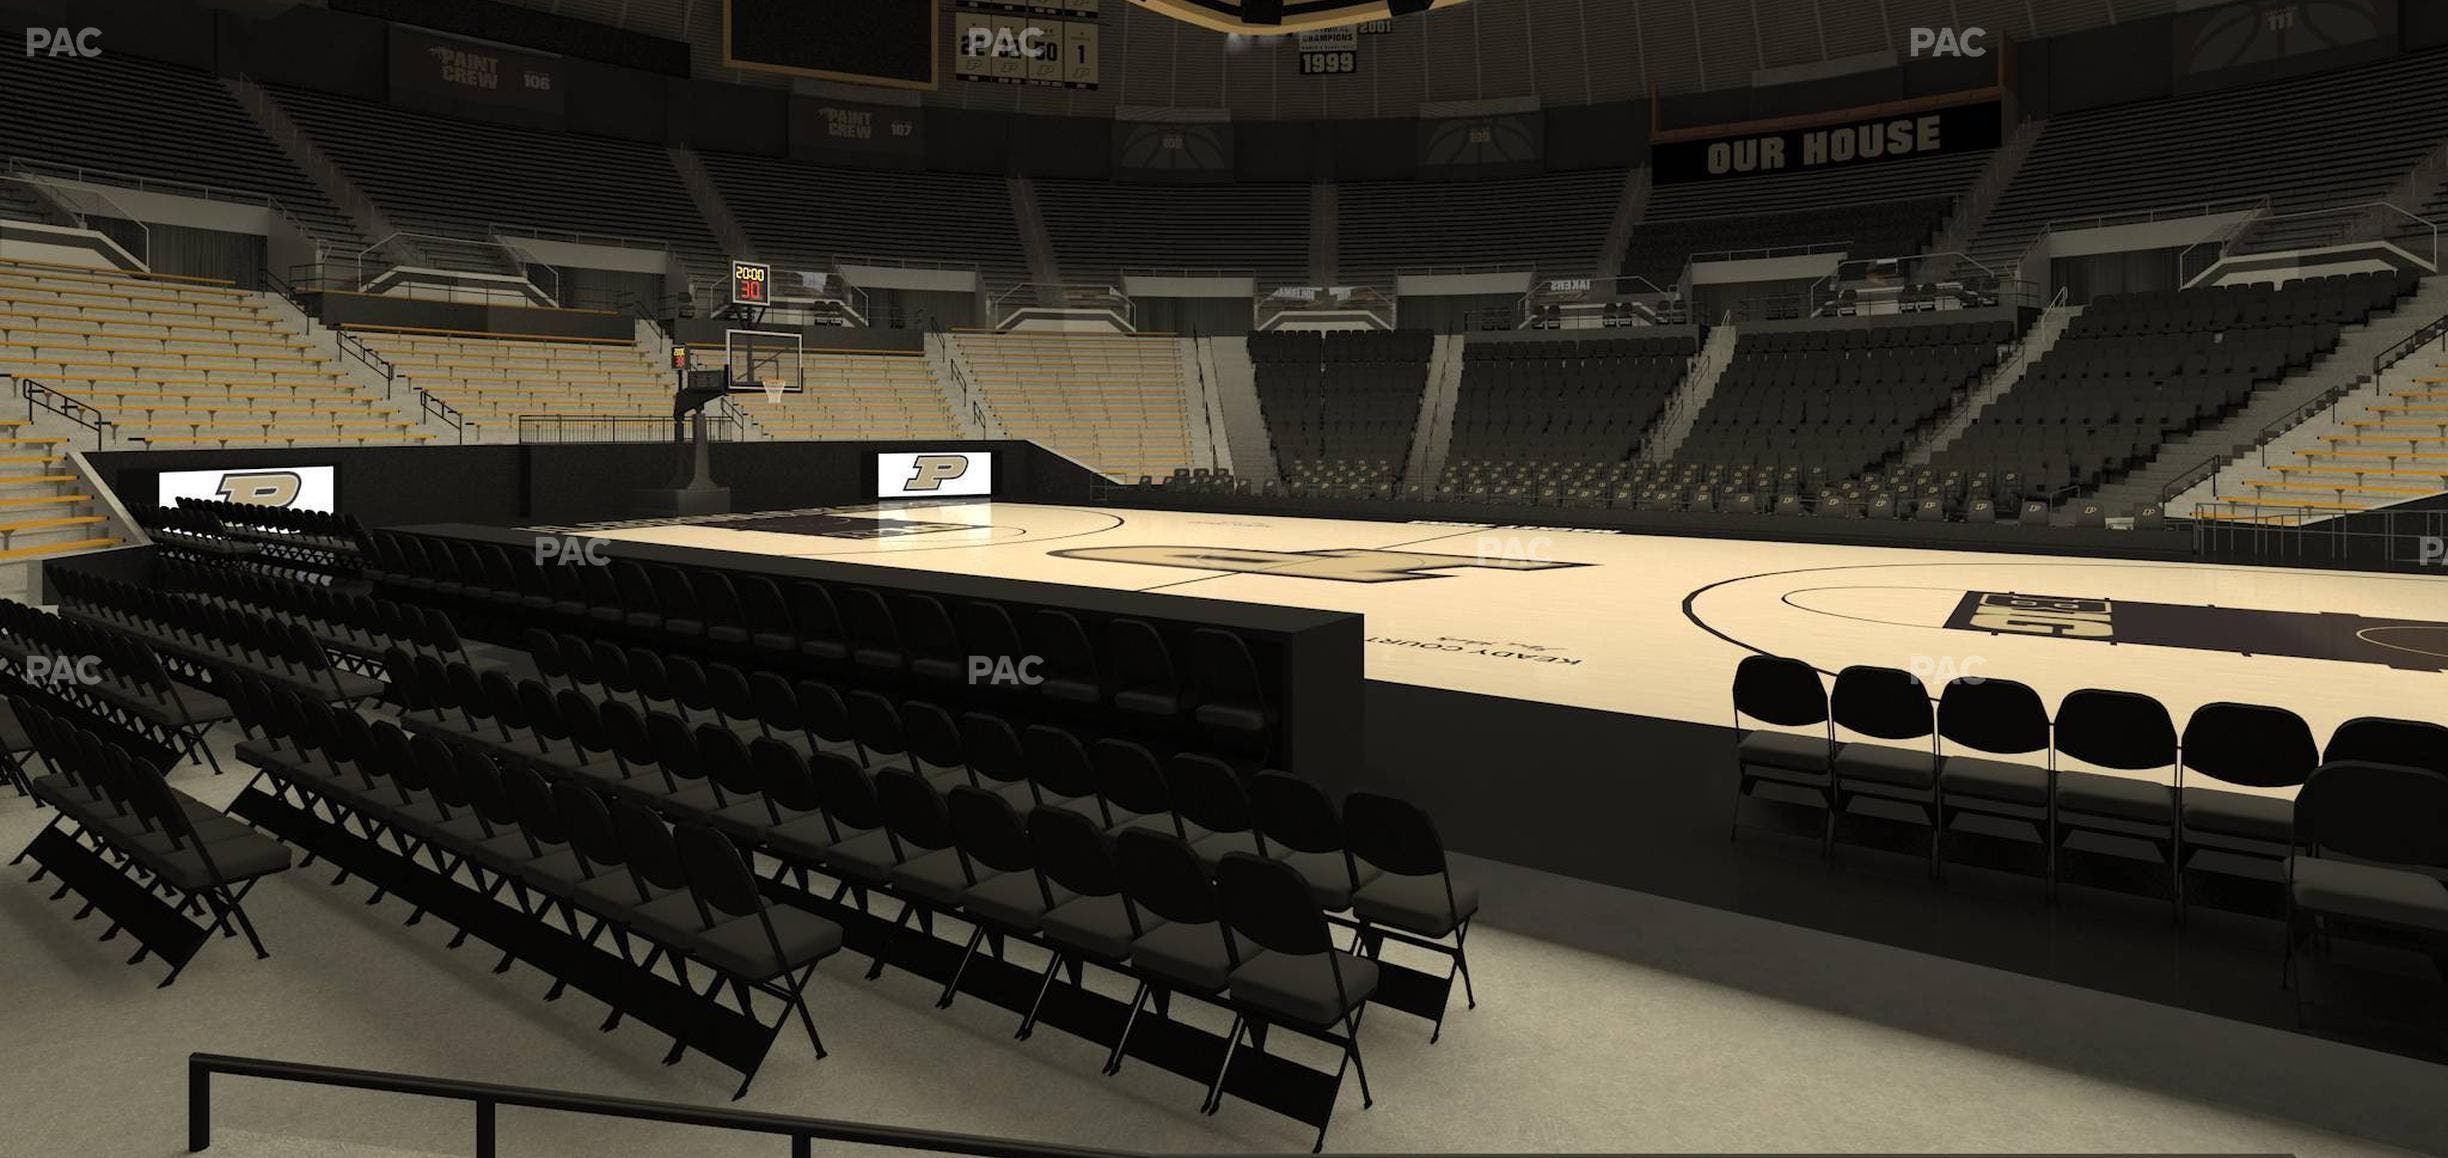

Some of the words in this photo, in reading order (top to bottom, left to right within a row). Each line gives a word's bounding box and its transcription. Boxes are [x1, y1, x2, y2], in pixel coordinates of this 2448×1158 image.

[1302, 52, 1354, 73] 1999
[1707, 136, 1786, 175] OUR
[1803, 115, 1942, 166] HOUSE
[735, 265, 765, 282] 20:00
[741, 280, 761, 300] 30
[903, 455, 969, 491] P
[1467, 648, 1582, 665] KEADY
